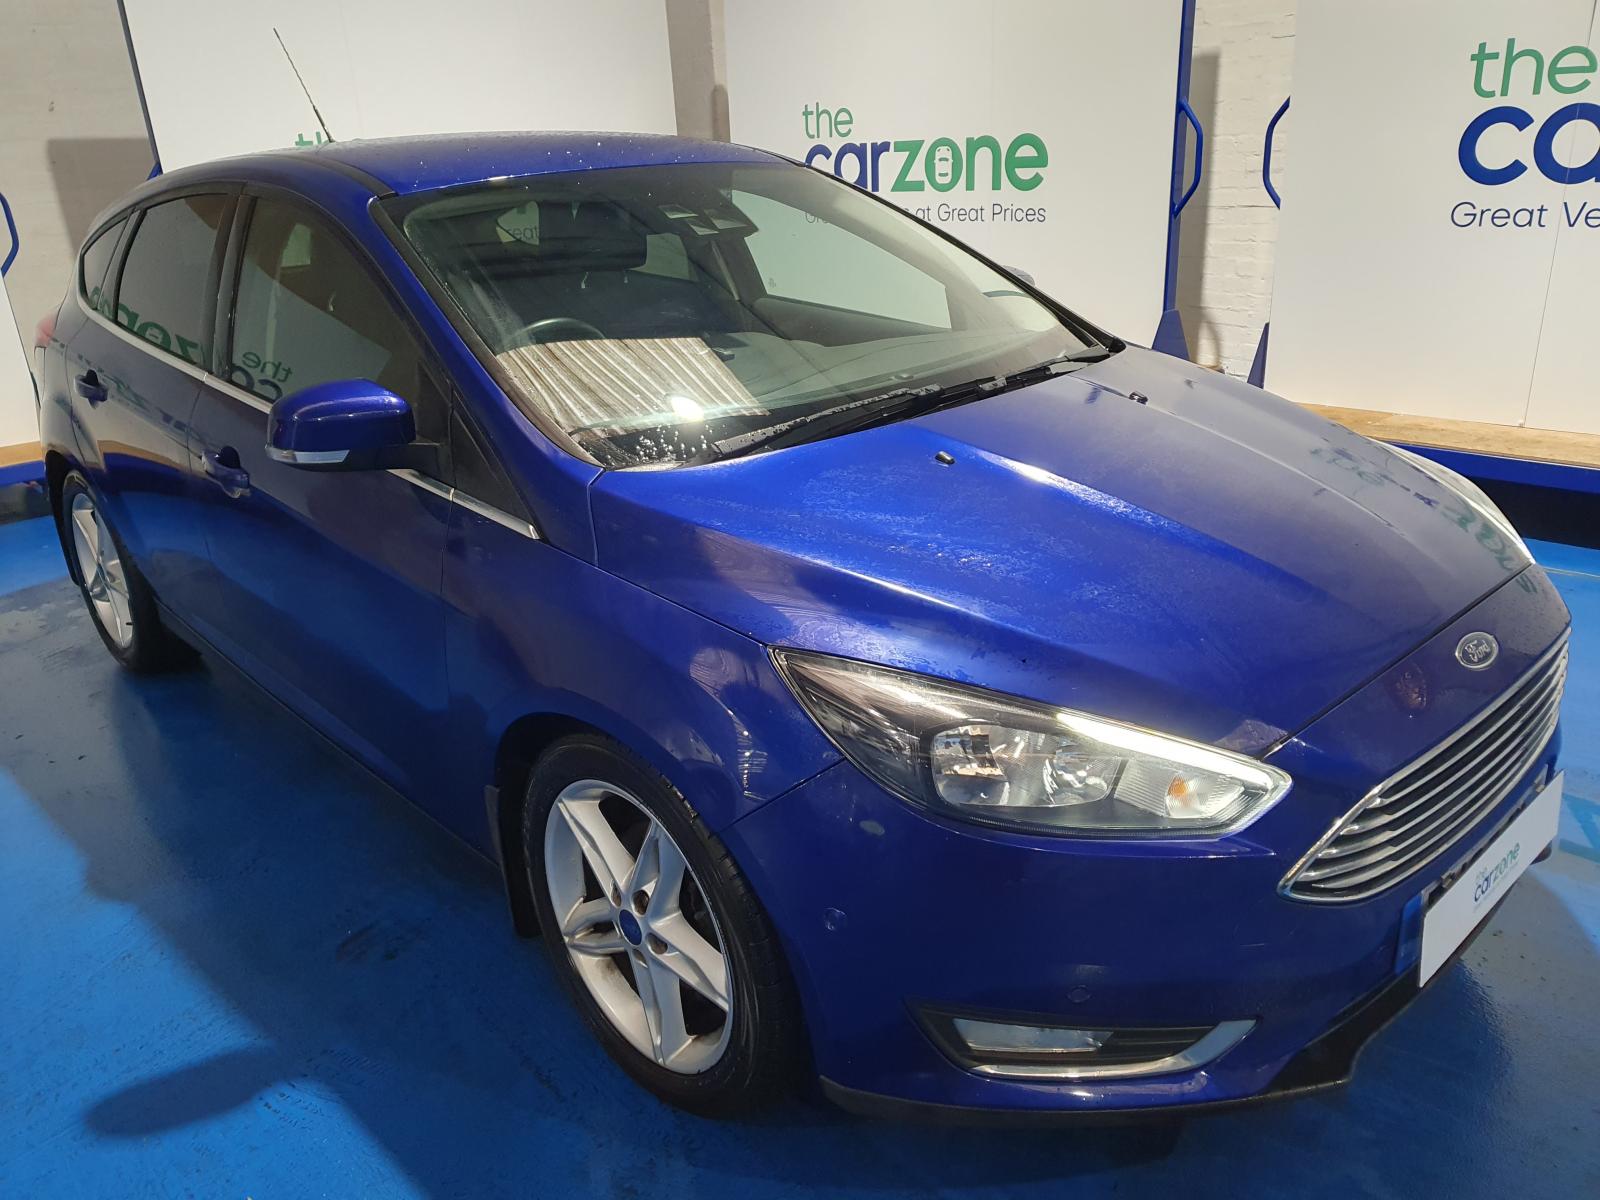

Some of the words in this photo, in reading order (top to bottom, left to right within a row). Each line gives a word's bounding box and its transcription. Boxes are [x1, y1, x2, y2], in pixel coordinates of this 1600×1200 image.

[1470, 37, 1598, 98] the
[802, 102, 854, 139] the
[915, 205, 932, 222] at
[937, 203, 985, 222] Great
[991, 203, 1046, 223] Prices
[1450, 201, 1549, 228] Great
[1474, 842, 1521, 902] carzone
